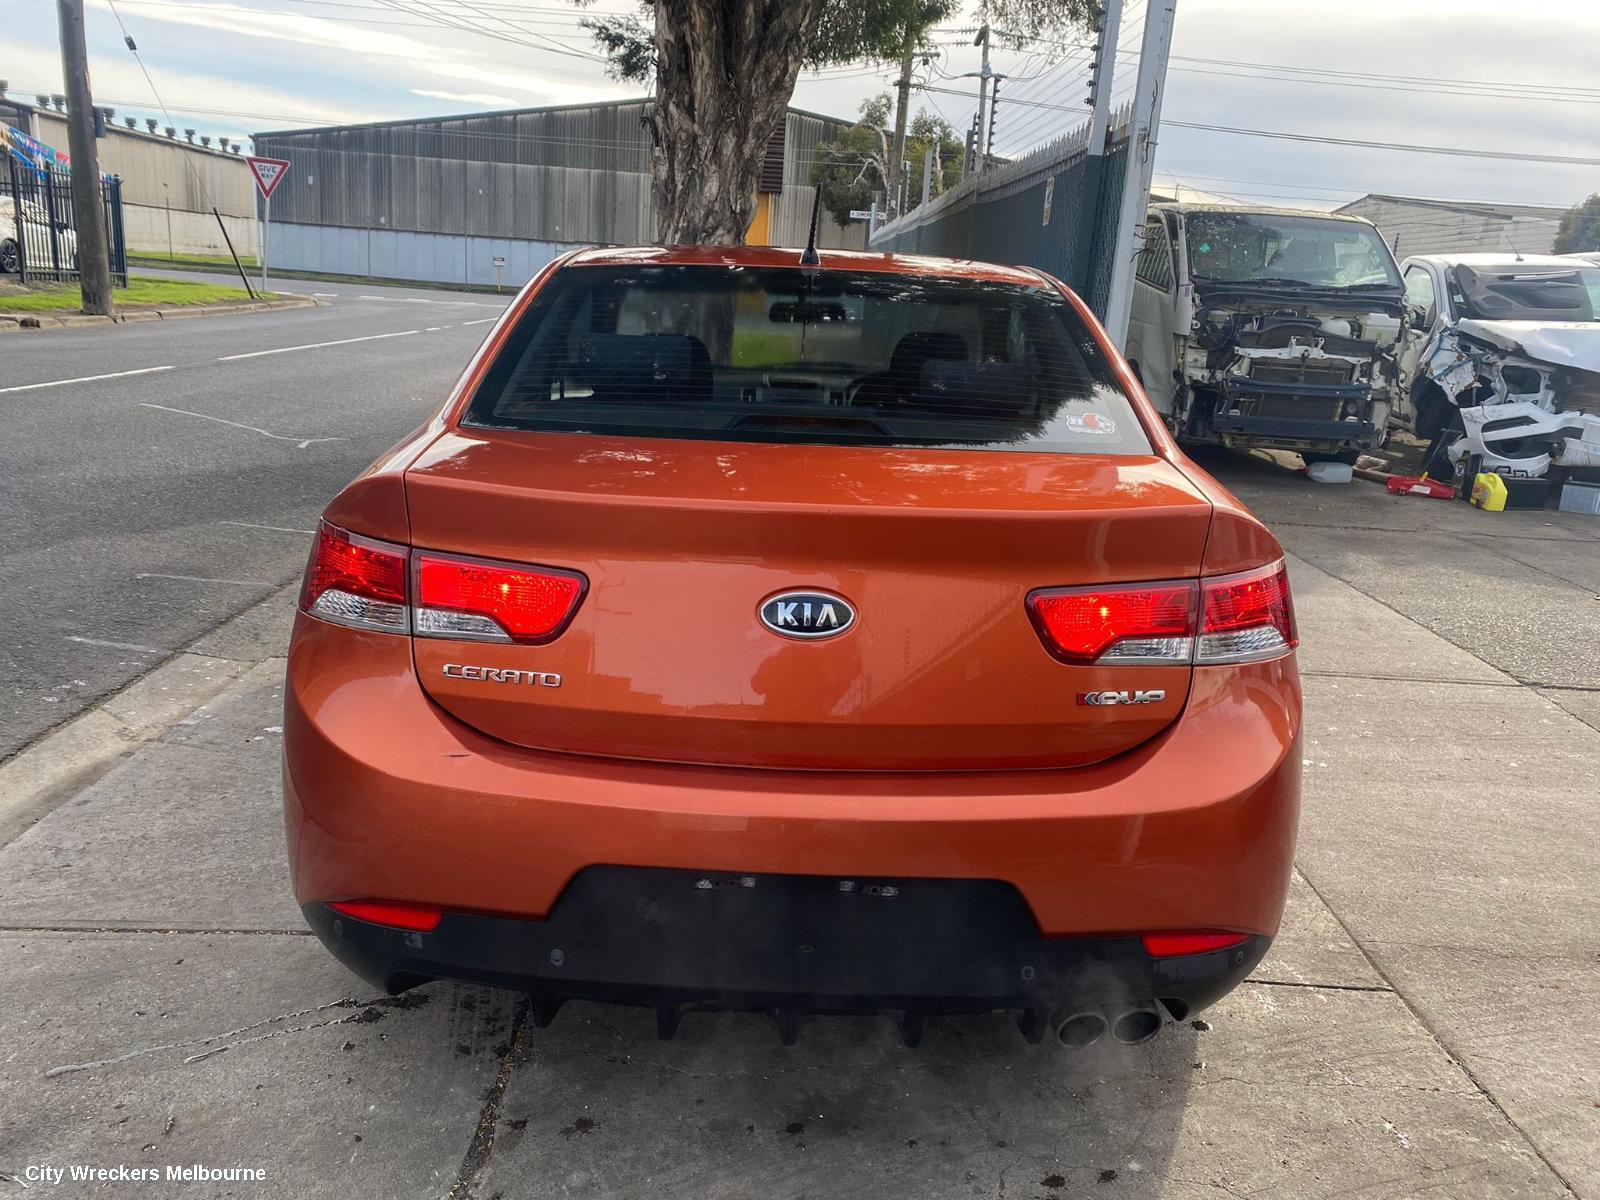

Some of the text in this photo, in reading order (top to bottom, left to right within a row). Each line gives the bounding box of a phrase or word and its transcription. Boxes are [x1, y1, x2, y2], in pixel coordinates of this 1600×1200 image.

[258, 164, 277, 173] GIVE
[777, 602, 839, 627] KIA
[442, 663, 562, 687] CERATO
[1077, 690, 1166, 704] KOUP
